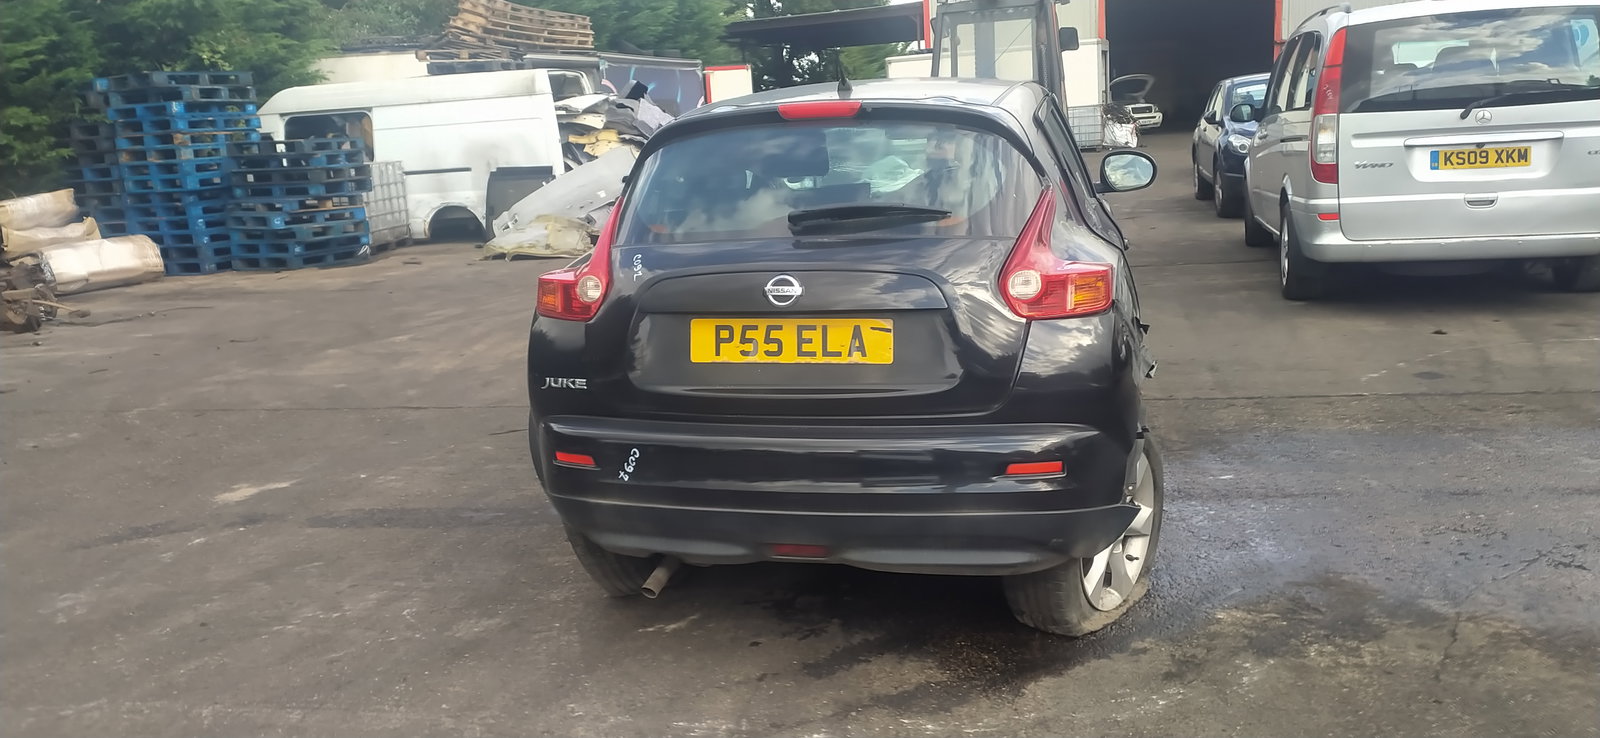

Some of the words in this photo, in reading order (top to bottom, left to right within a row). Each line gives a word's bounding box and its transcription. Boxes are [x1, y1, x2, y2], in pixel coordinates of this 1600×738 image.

[1443, 150, 1489, 167] KS09
[1494, 148, 1528, 164] XKM
[714, 324, 784, 358] P55
[796, 324, 868, 358] ELA
[540, 377, 588, 390] JUKE
